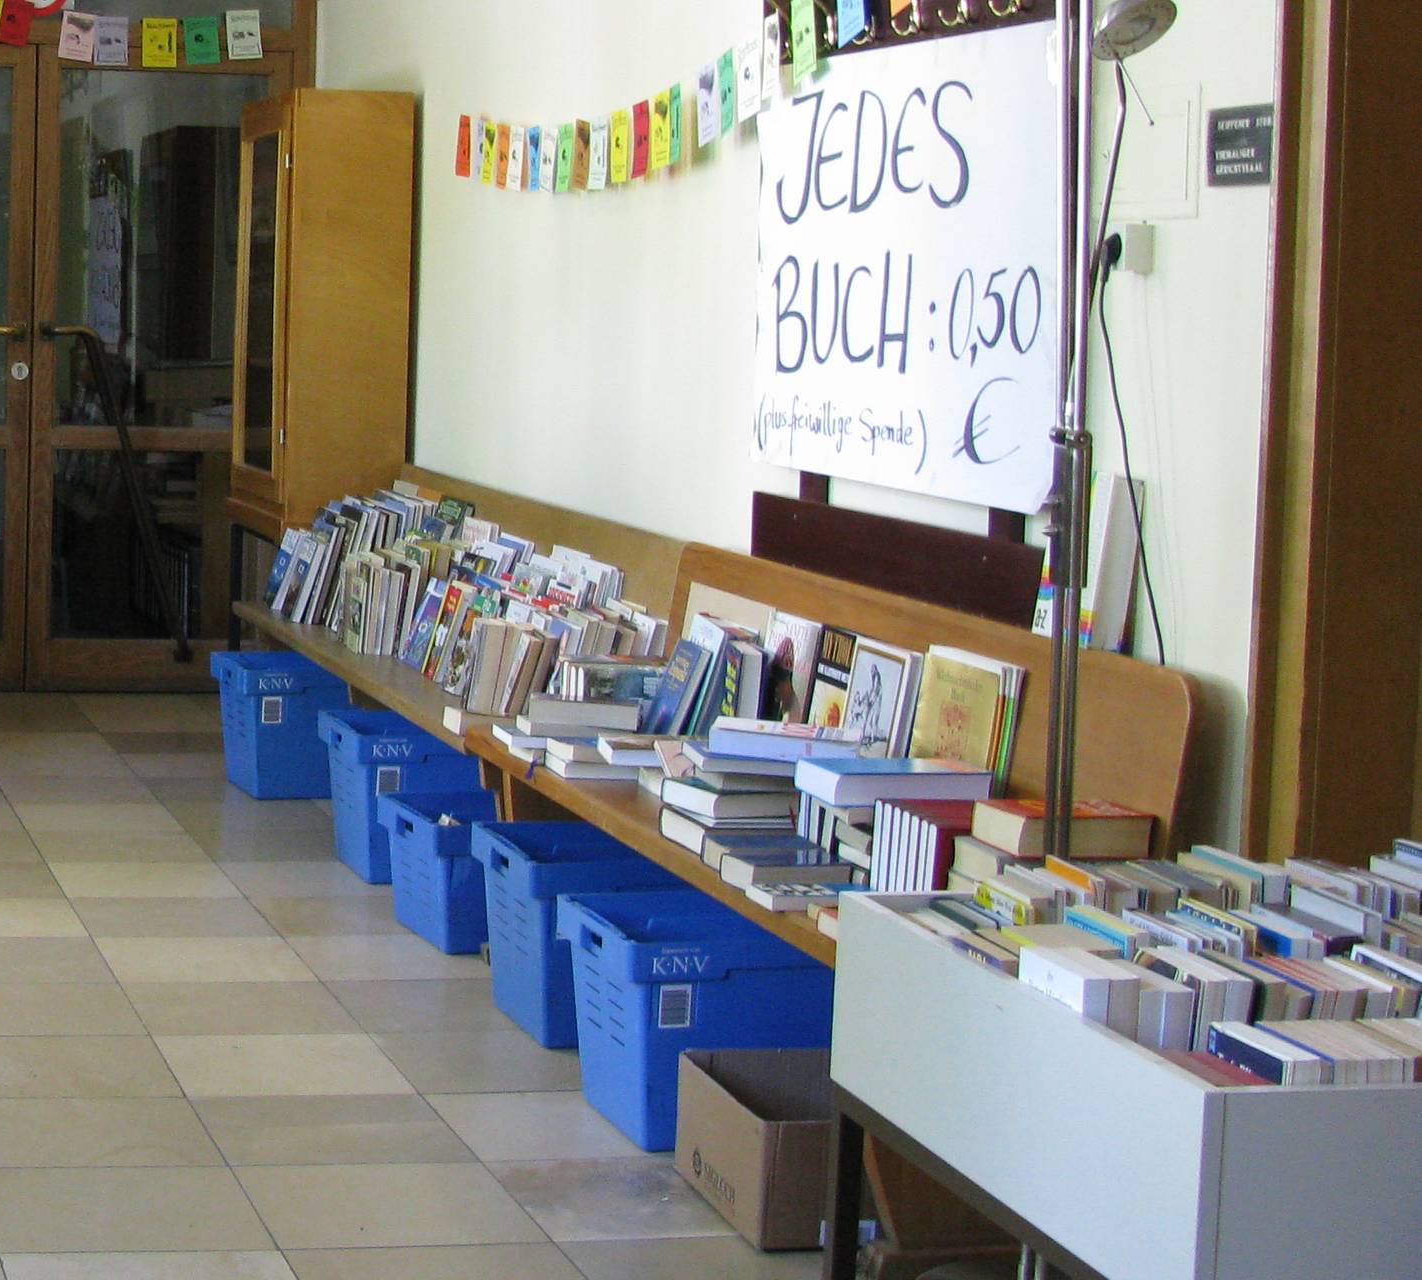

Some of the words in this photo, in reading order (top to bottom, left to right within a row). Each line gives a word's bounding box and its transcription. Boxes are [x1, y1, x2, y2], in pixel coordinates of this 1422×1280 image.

[775, 80, 973, 225] JEDES
[771, 249, 913, 376] BUCH
[948, 265, 1042, 368] 0,50
[786, 394, 853, 456] freiwillige
[952, 376, 1021, 465] €
